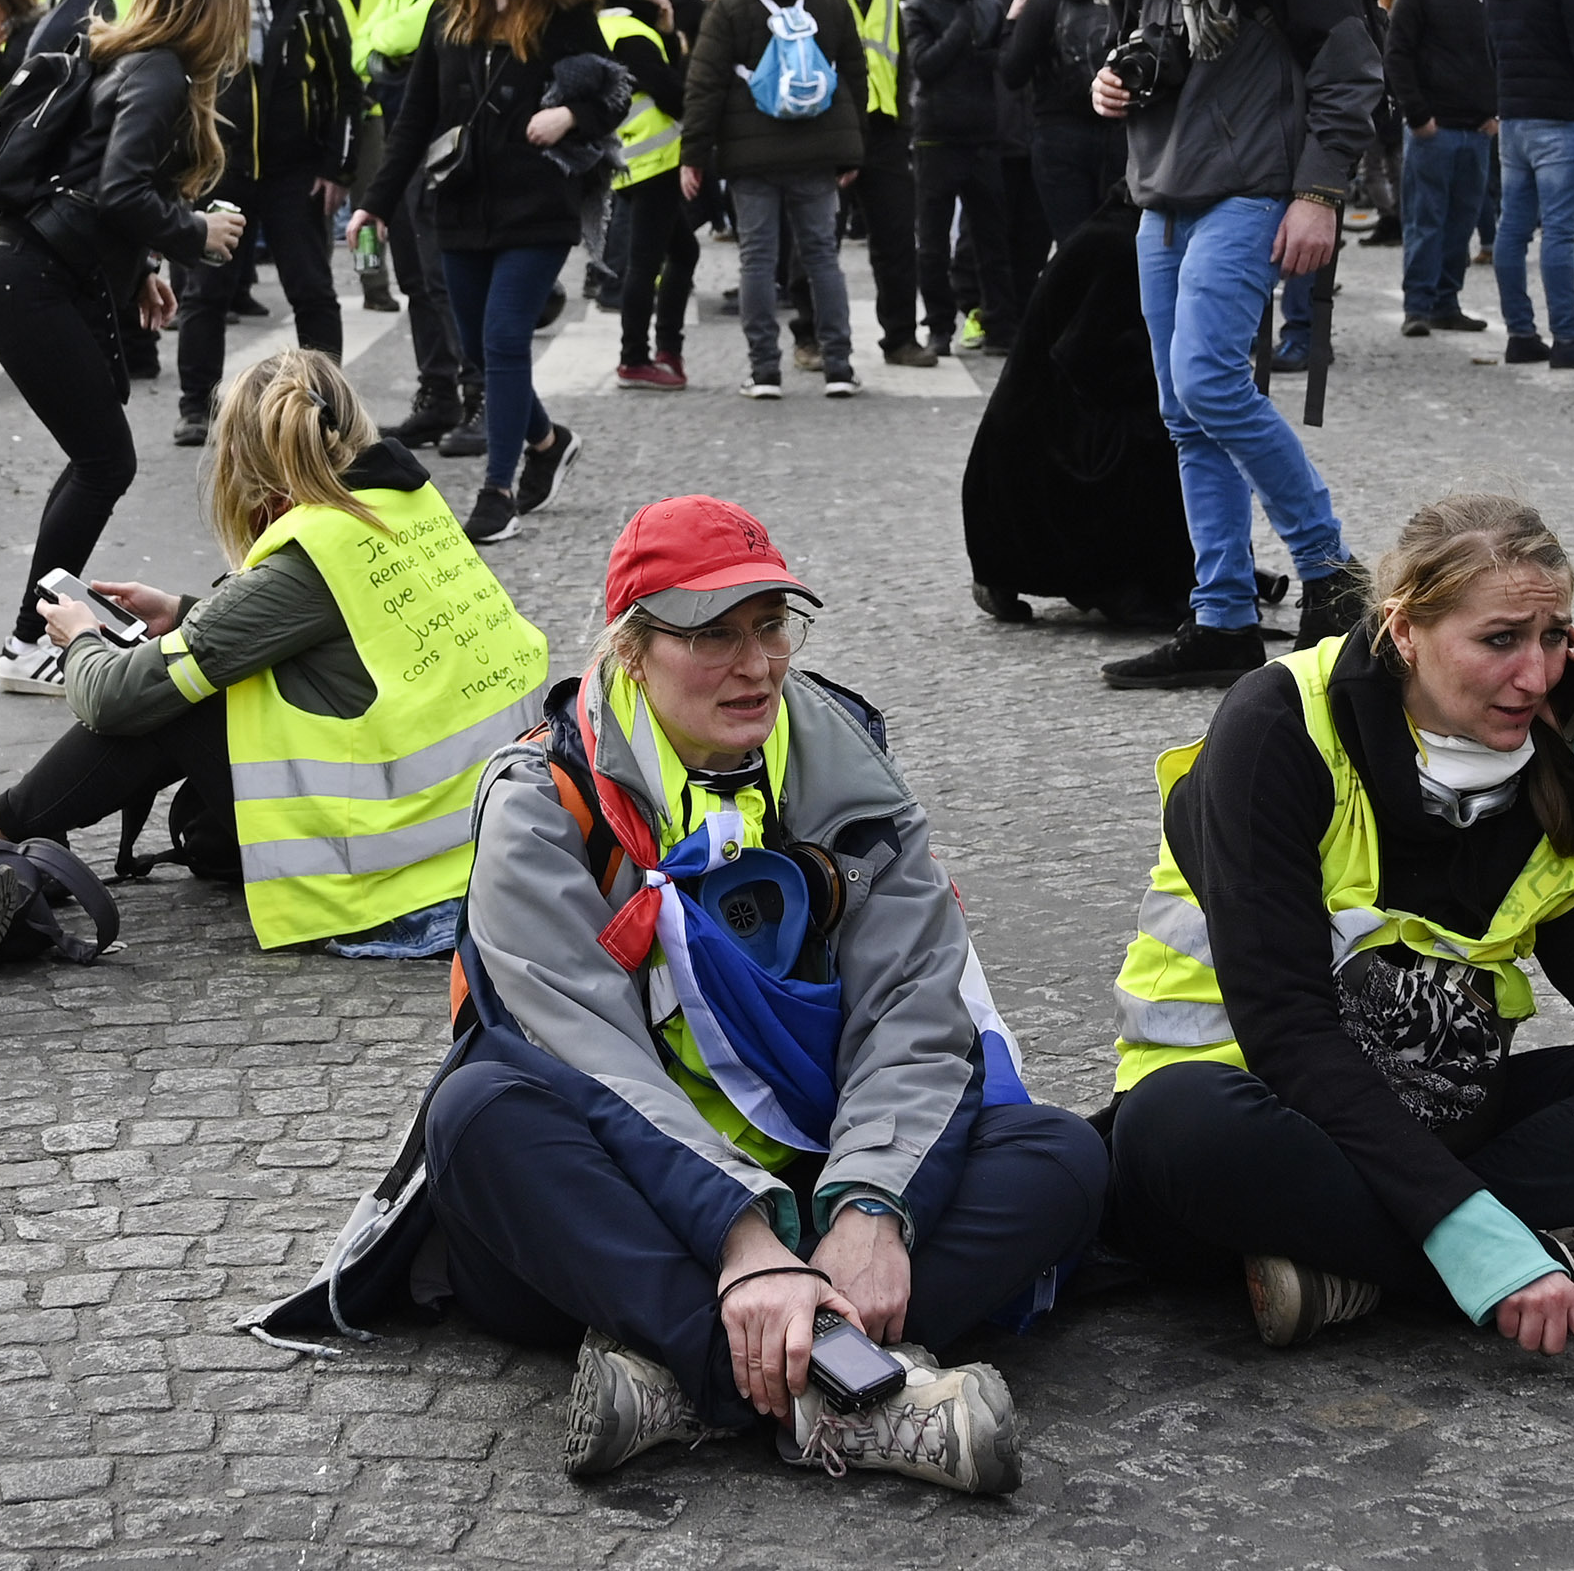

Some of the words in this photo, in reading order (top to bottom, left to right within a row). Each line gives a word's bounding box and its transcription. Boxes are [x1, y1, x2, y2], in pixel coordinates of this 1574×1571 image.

[357, 535, 389, 564] Je
[418, 544, 436, 561] la
[383, 587, 417, 621] que
[402, 649, 441, 683] cons
